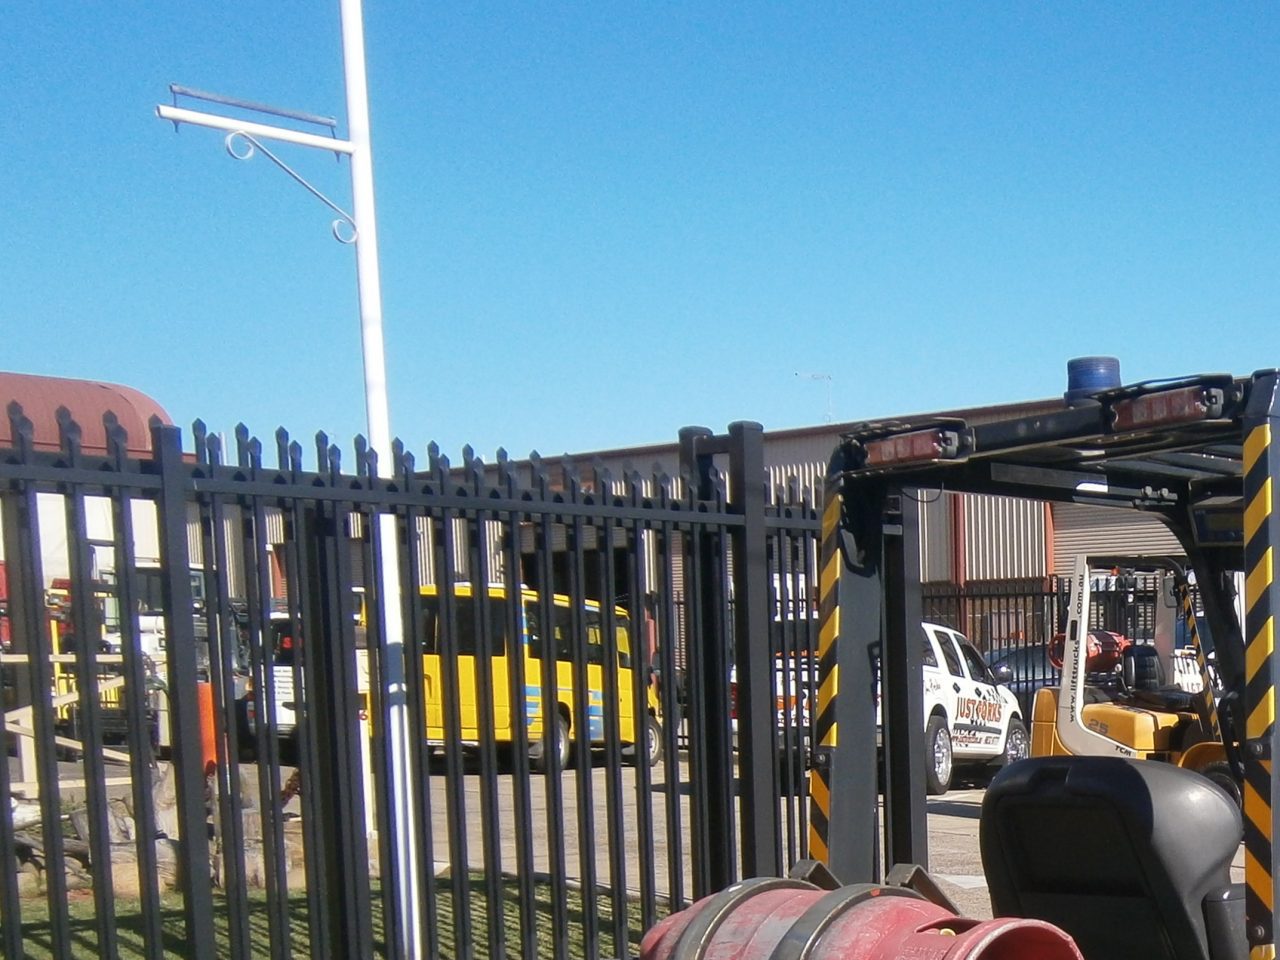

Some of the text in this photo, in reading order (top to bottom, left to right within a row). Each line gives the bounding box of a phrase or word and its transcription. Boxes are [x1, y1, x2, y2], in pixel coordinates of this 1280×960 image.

[955, 696, 977, 721] JUST
[1089, 719, 1109, 735] 25
[1115, 745, 1132, 757] TCM
